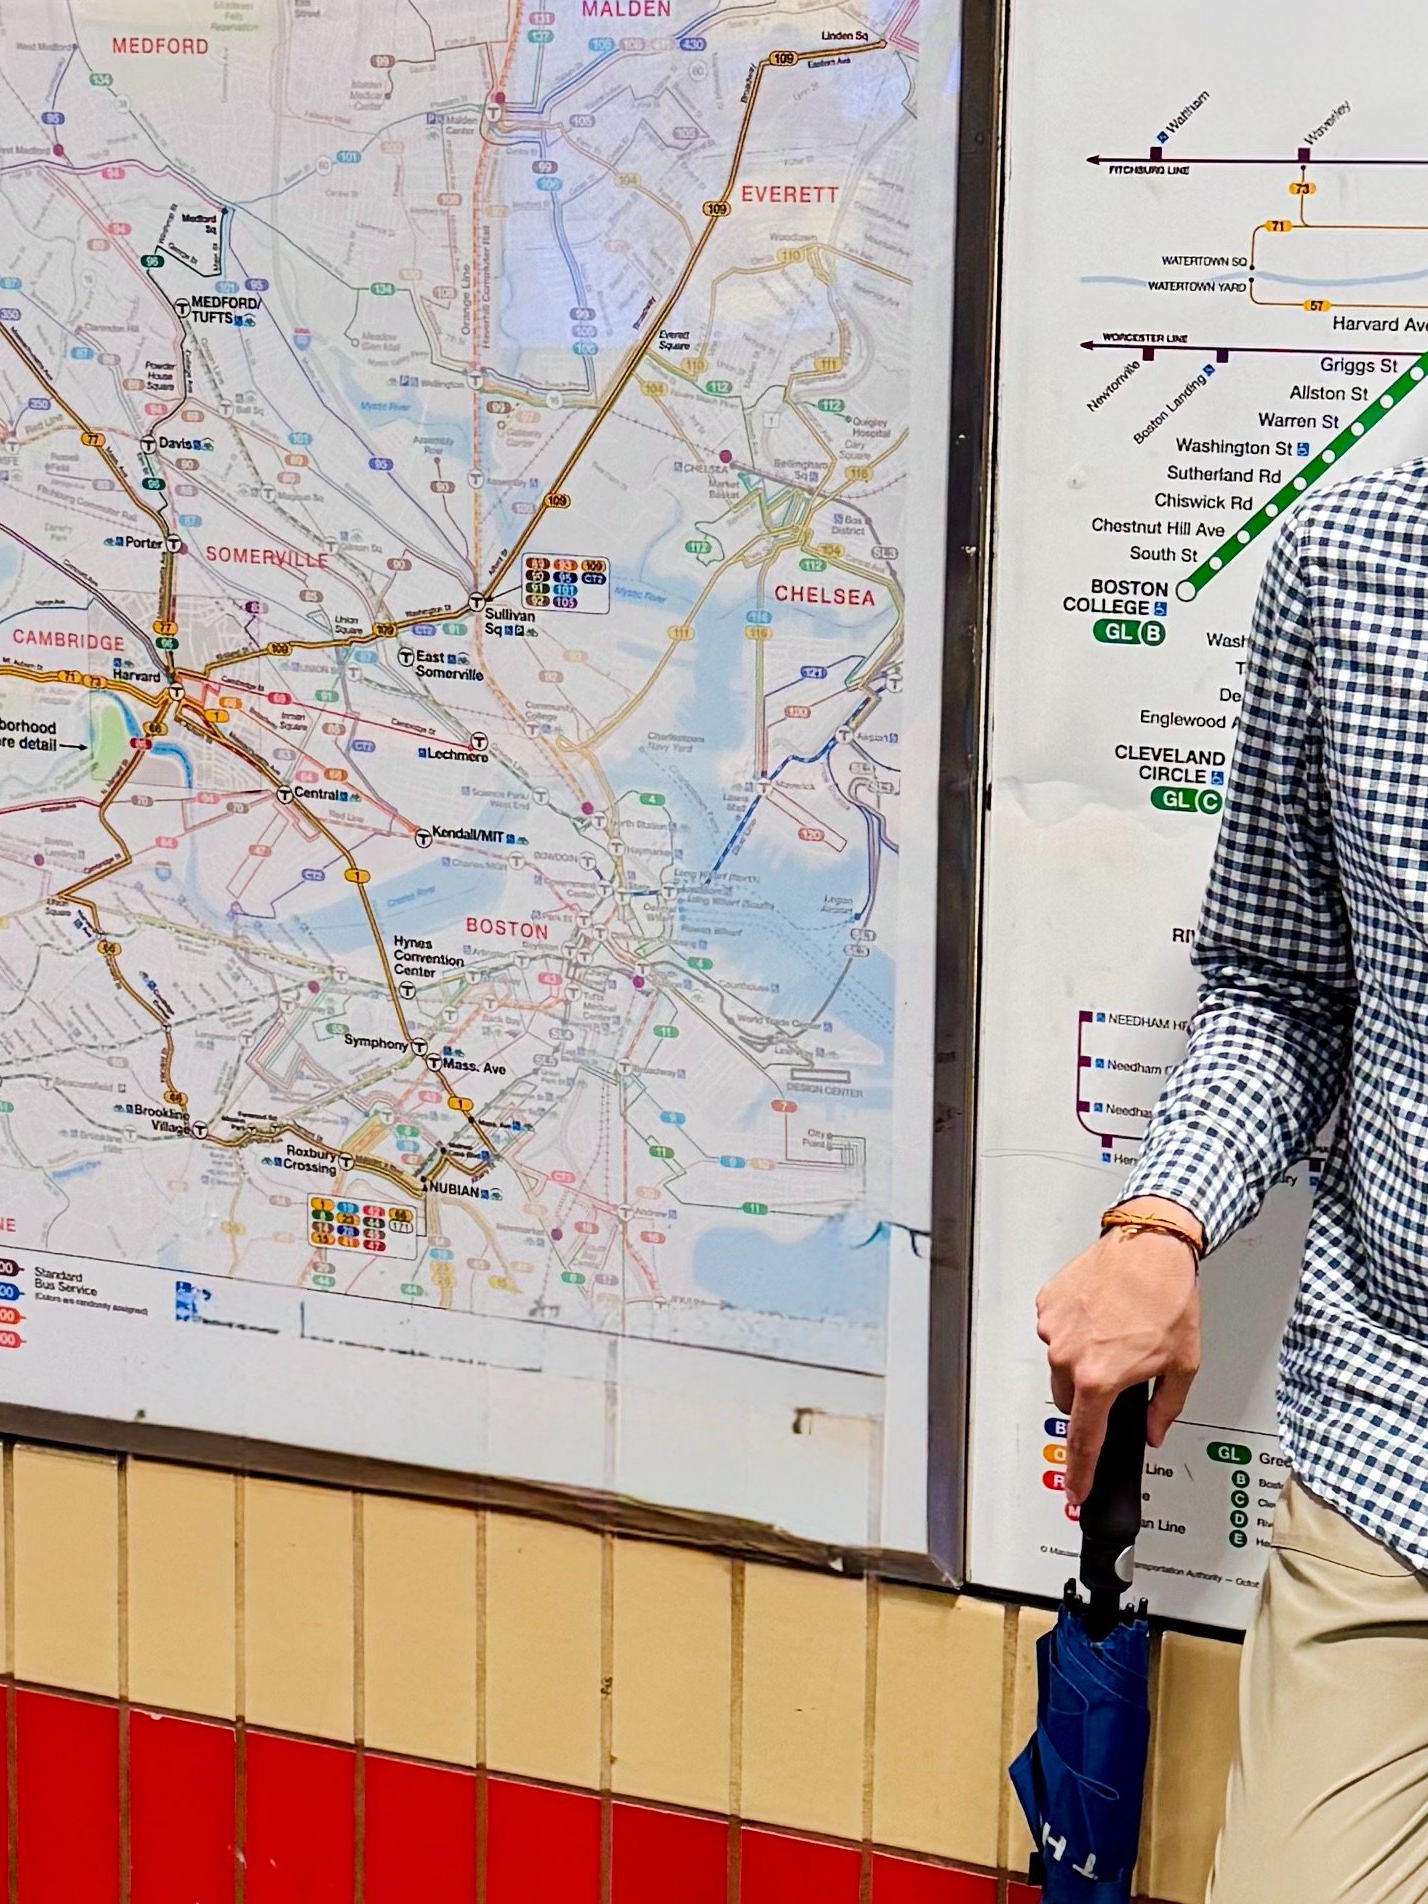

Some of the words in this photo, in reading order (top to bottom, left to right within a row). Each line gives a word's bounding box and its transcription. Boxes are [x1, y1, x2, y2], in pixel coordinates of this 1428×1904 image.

[581, 0, 670, 17] MALDEN
[112, 37, 207, 54] MEDFORD
[773, 52, 794, 65] 109
[741, 184, 838, 204] EVERETT
[1333, 316, 1398, 331] Harvard
[1321, 357, 1375, 375] Griggs
[1381, 359, 1397, 373] St
[1290, 385, 1345, 400] Allston
[1351, 387, 1367, 401] St
[1259, 413, 1316, 428] Warren
[1322, 415, 1338, 429] St
[1176, 438, 1269, 457] Washington
[1276, 441, 1292, 456] St
[1168, 465, 1253, 482] Sutherland
[1260, 469, 1281, 483] Rd
[1155, 493, 1225, 509] Chiswick
[1231, 496, 1252, 510] Rd
[1092, 517, 1161, 535] Chestnut
[1168, 522, 1190, 535] Hill
[1196, 523, 1225, 537] Ave
[126, 536, 163, 549] Porter
[206, 546, 328, 569] SOMERVILLE
[1131, 546, 1175, 561] South
[1181, 548, 1197, 562] St
[775, 584, 876, 607] CHELSEA
[1092, 579, 1168, 597] BOSTON
[1063, 597, 1149, 615] COLLEGE
[12, 627, 123, 653] CAMBRIDGE
[1106, 623, 1132, 640] GL
[19, 737, 56, 751] detail
[1115, 745, 1225, 766] CLEVELAND
[1139, 765, 1206, 783] CIRCLE
[1164, 791, 1190, 807] GL
[433, 825, 504, 842] Kendall/MIT
[465, 916, 548, 940] BOSTON
[345, 1033, 409, 1053] Symphony
[430, 1180, 479, 1198] NUBIAN
